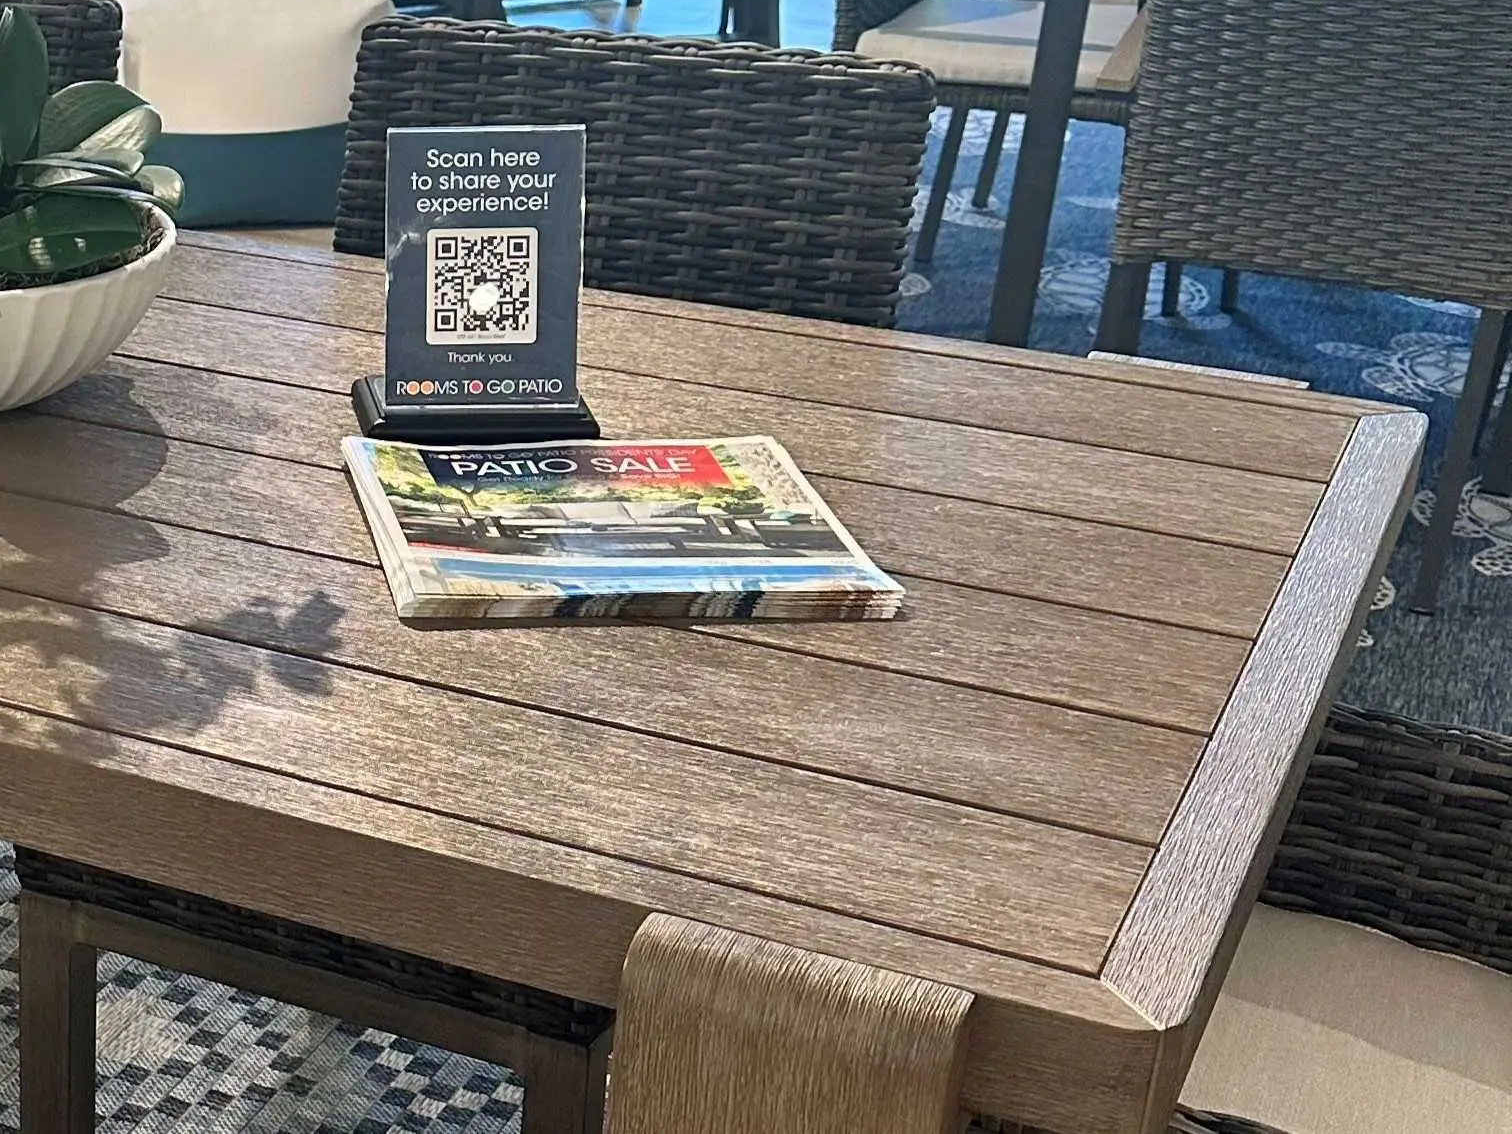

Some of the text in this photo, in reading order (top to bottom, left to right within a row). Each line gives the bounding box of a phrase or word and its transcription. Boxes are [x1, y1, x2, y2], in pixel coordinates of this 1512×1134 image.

[427, 147, 540, 168] Scan here
[410, 171, 557, 193] to share your
[416, 191, 548, 216] experience!
[447, 351, 485, 363] Thank
[396, 379, 563, 395] ROOMS TO GO PATIO
[488, 452, 505, 461] TO
[508, 451, 533, 459] GO
[537, 448, 576, 458] PATIO
[452, 456, 696, 476] PATIO SALE
